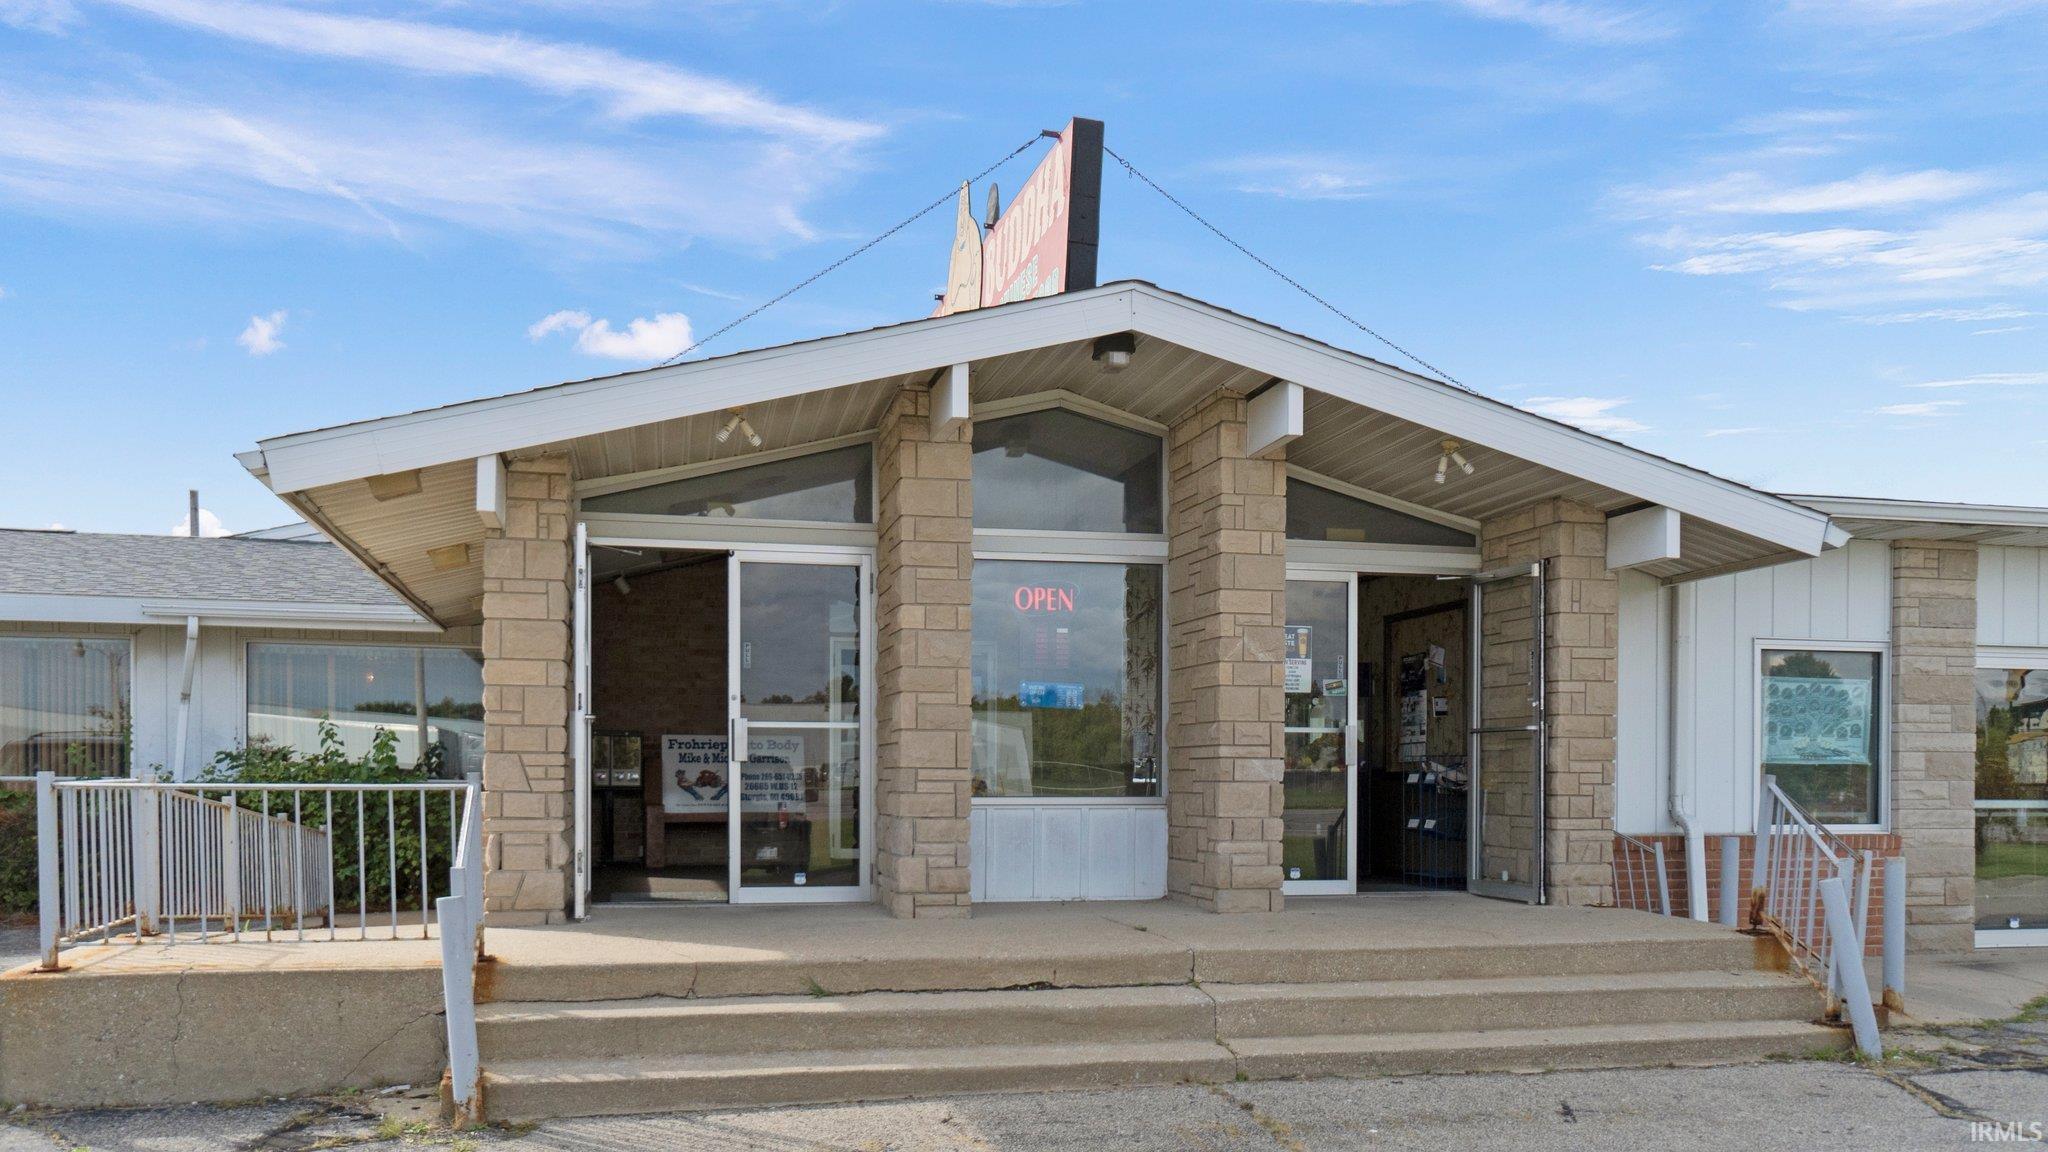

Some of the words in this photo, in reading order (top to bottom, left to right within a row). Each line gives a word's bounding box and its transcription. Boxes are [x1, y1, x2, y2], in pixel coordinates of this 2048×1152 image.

[1014, 586, 1073, 611] OPEN
[668, 739, 728, 752] Frohriep
[766, 739, 800, 752] Body
[679, 752, 701, 763] Mike
[703, 752, 710, 764] &
